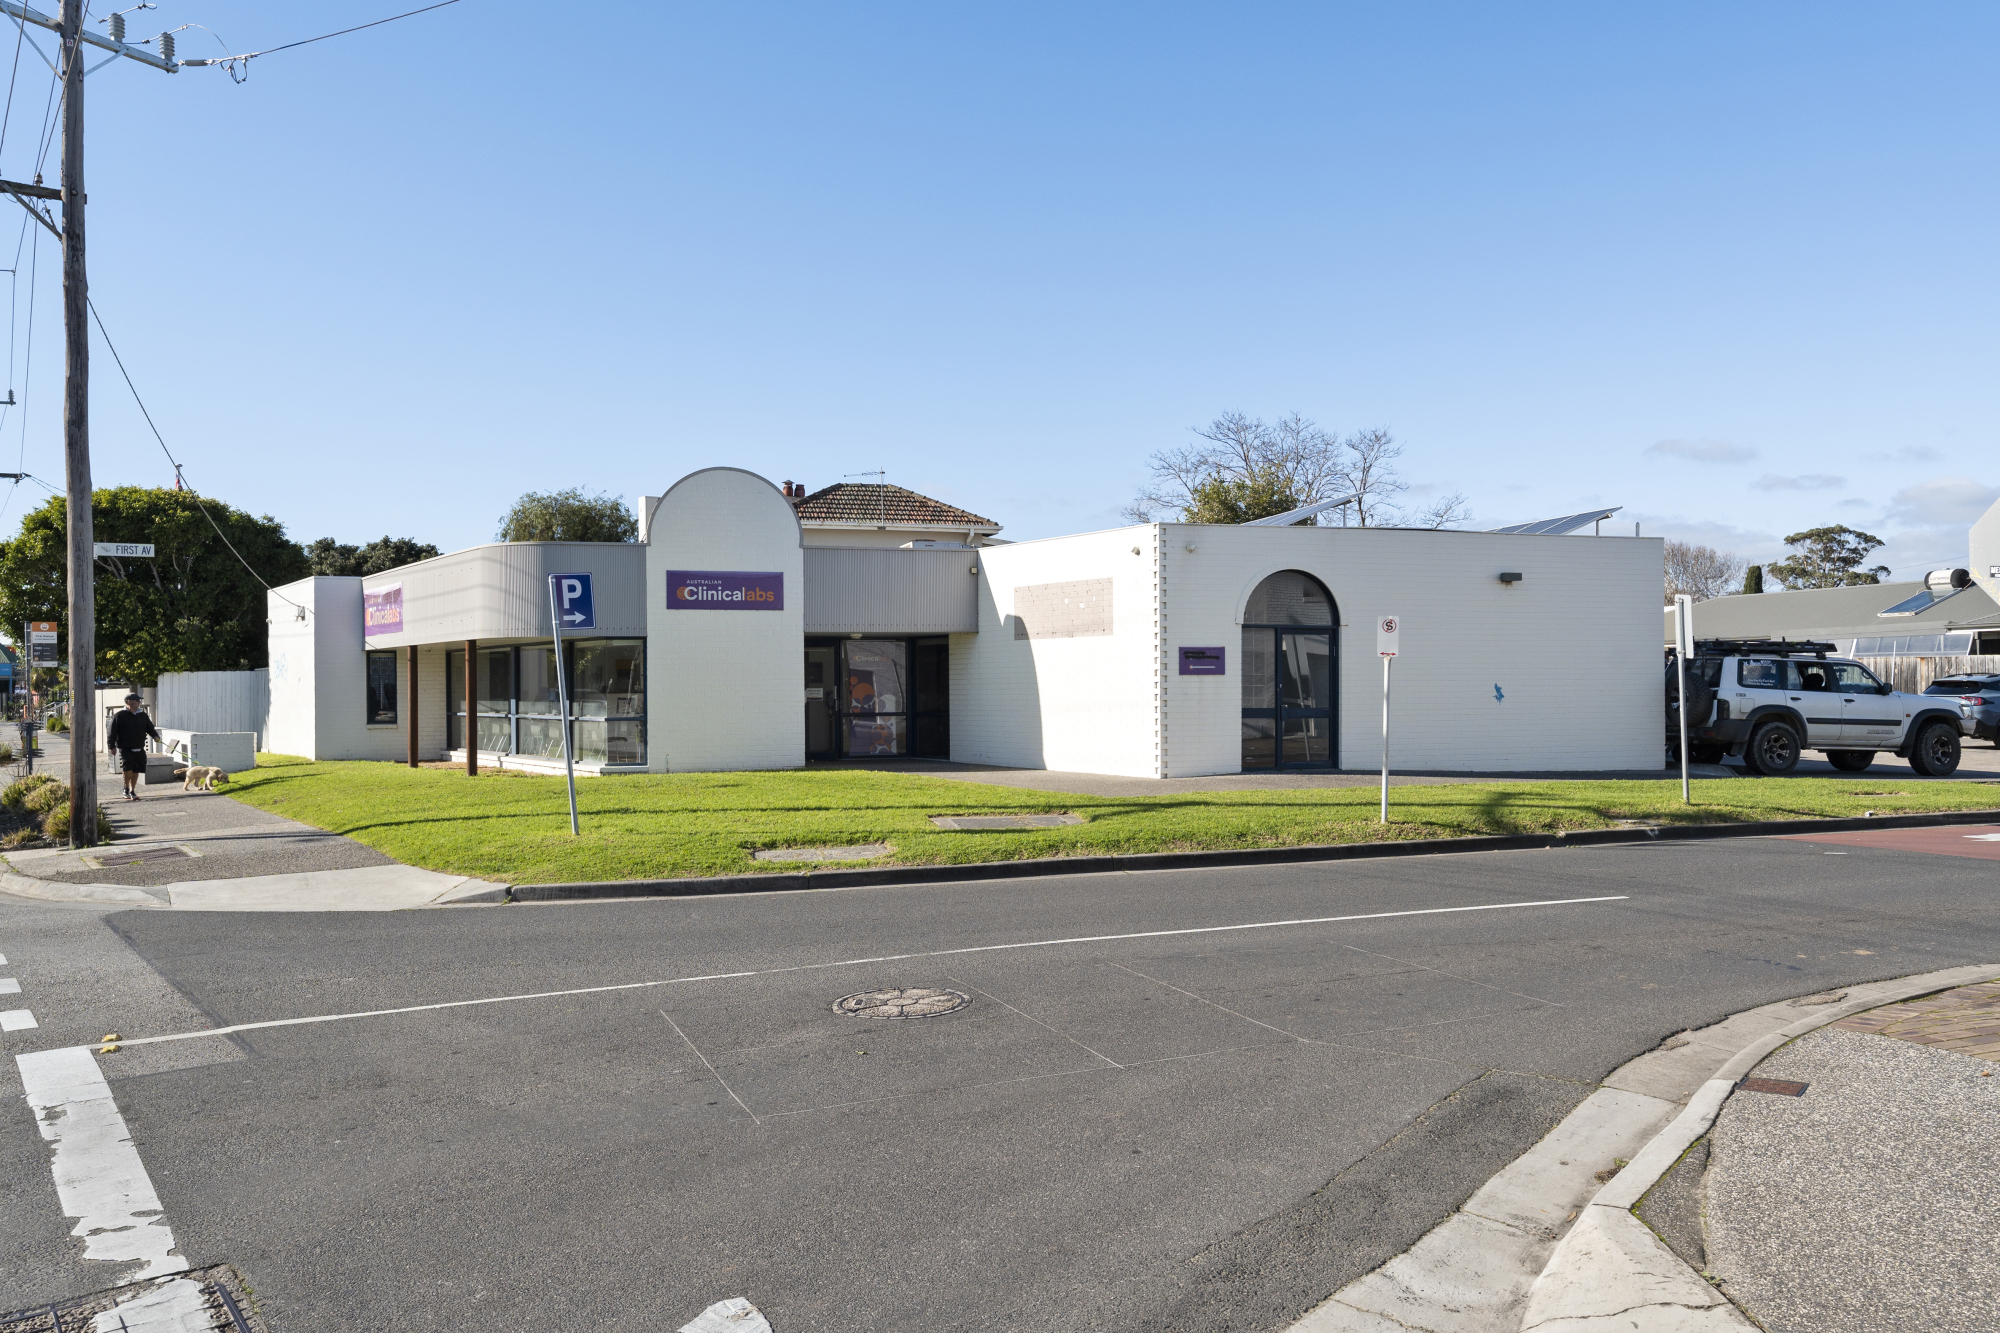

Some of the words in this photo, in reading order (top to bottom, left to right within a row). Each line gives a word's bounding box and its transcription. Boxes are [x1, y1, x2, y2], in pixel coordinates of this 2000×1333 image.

[115, 545, 139, 555] FIRST
[141, 546, 152, 556] AV
[562, 579, 582, 609] P
[684, 586, 775, 602] Clinicalabs
[1385, 621, 1394, 631] S
